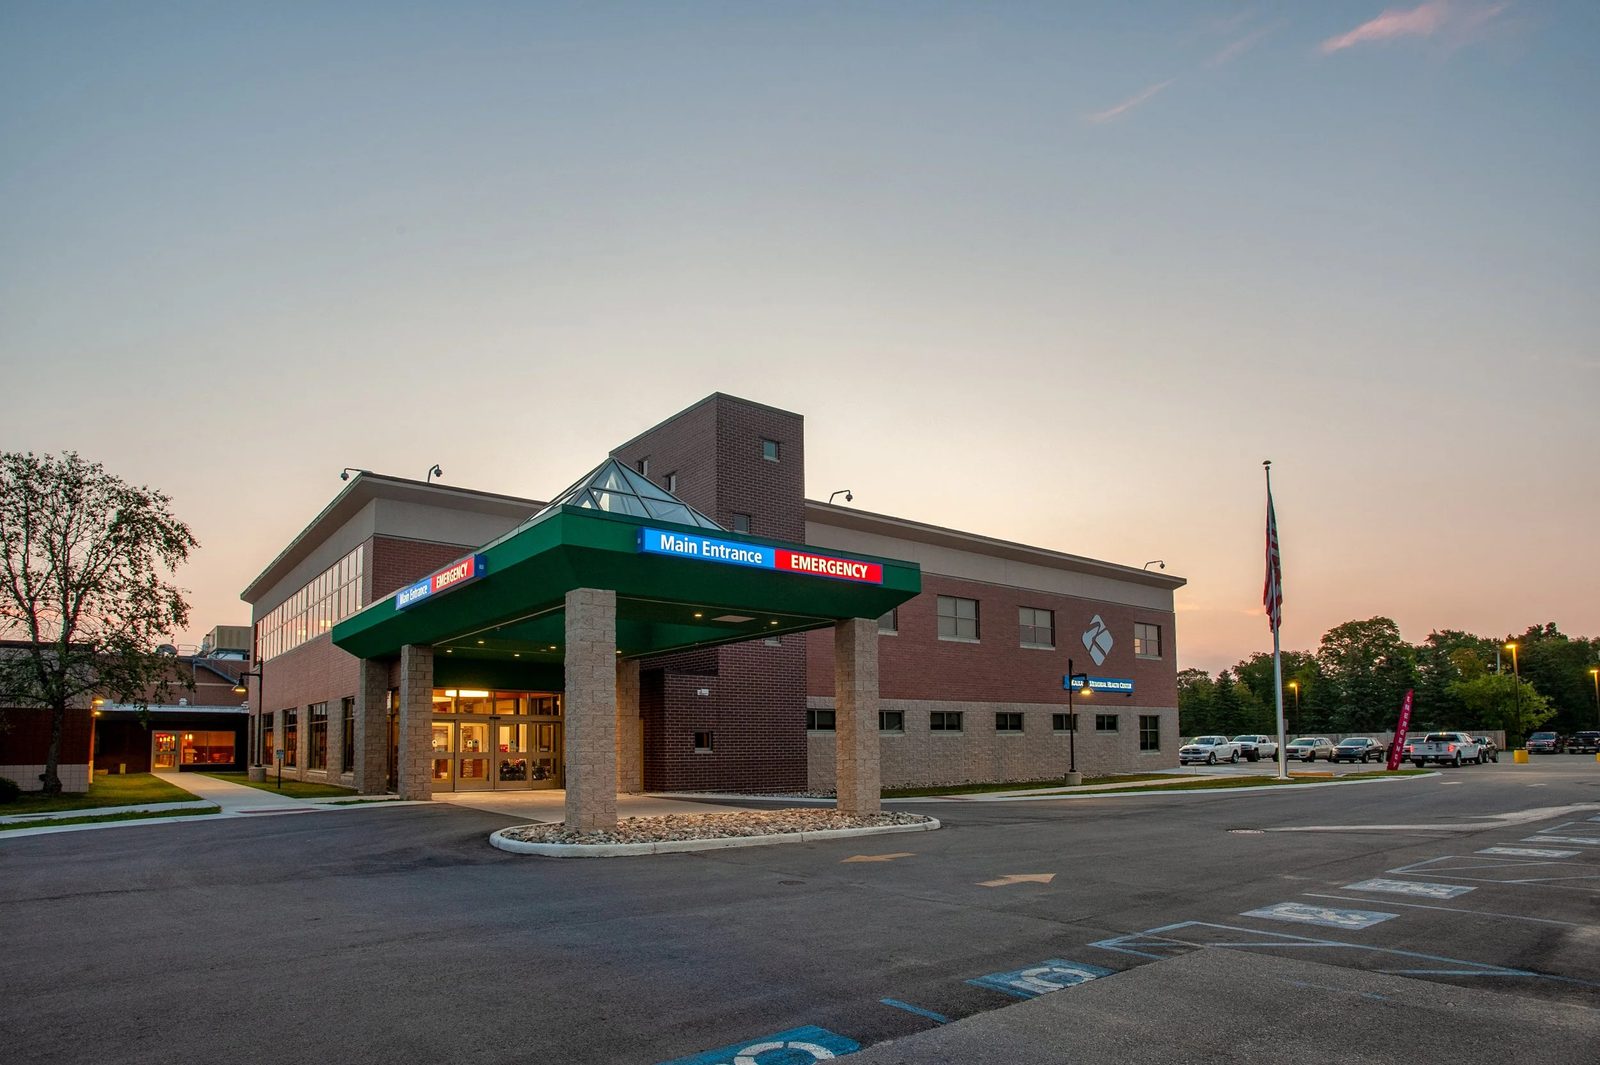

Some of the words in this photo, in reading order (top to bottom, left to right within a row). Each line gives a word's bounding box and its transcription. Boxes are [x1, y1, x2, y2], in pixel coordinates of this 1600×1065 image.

[436, 562, 468, 589] EMERGENCY
[661, 534, 698, 554] Main
[702, 541, 763, 564] Entrance
[791, 555, 869, 579] EMERGENCY
[1393, 696, 1411, 768] EMERGENCY
